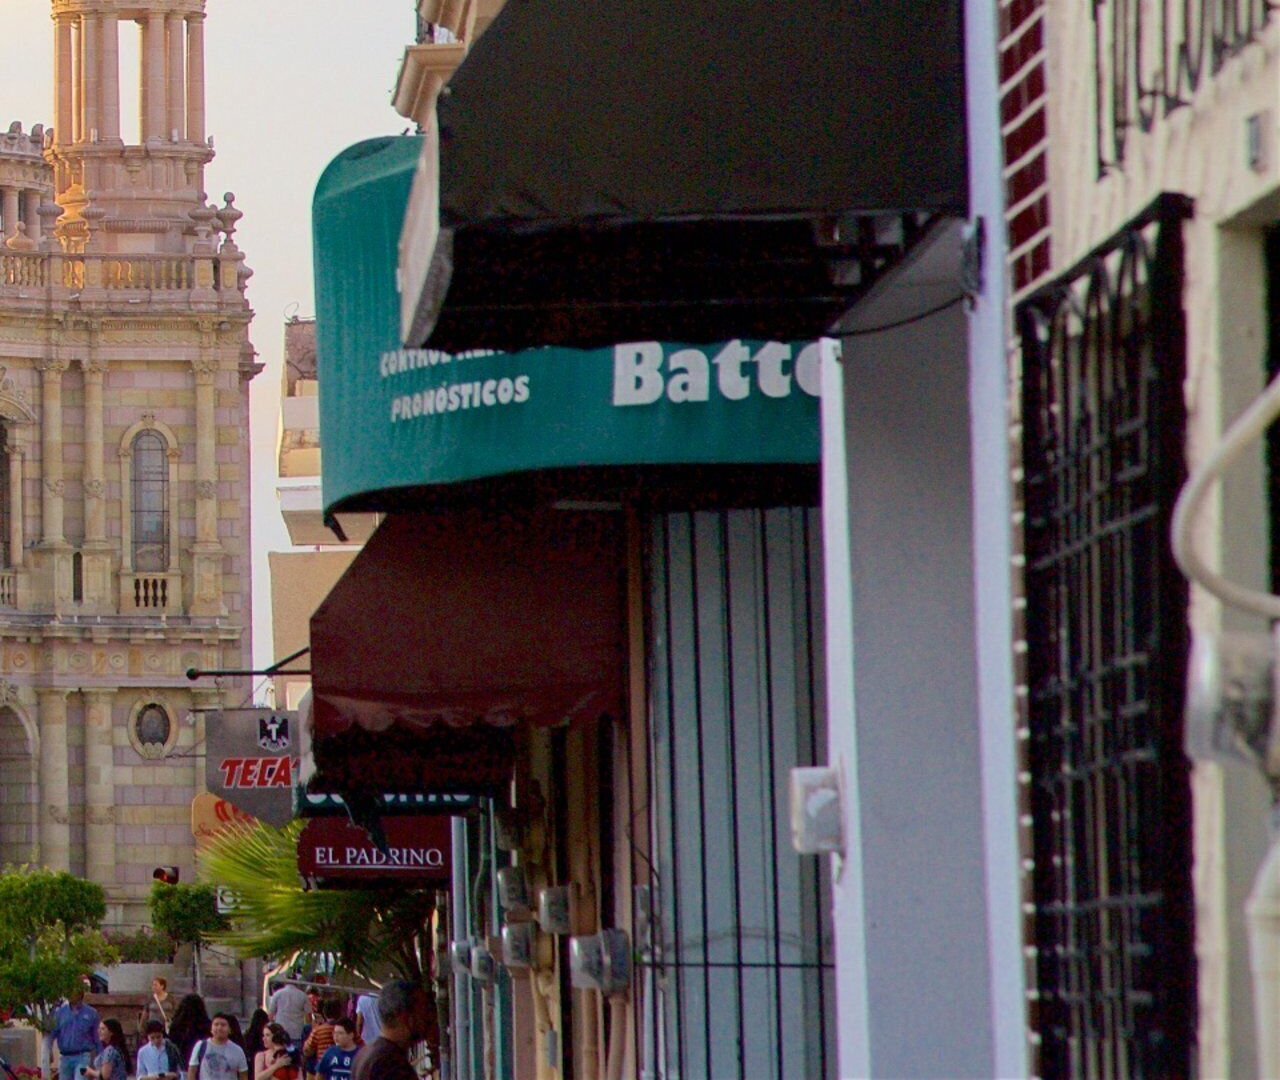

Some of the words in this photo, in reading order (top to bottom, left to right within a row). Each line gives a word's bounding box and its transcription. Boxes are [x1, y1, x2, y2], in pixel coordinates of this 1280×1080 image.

[391, 375, 530, 423] PRONÓSTICOS
[220, 756, 298, 789] TECA
[315, 847, 340, 865] EL
[345, 847, 444, 866] PADRINO
